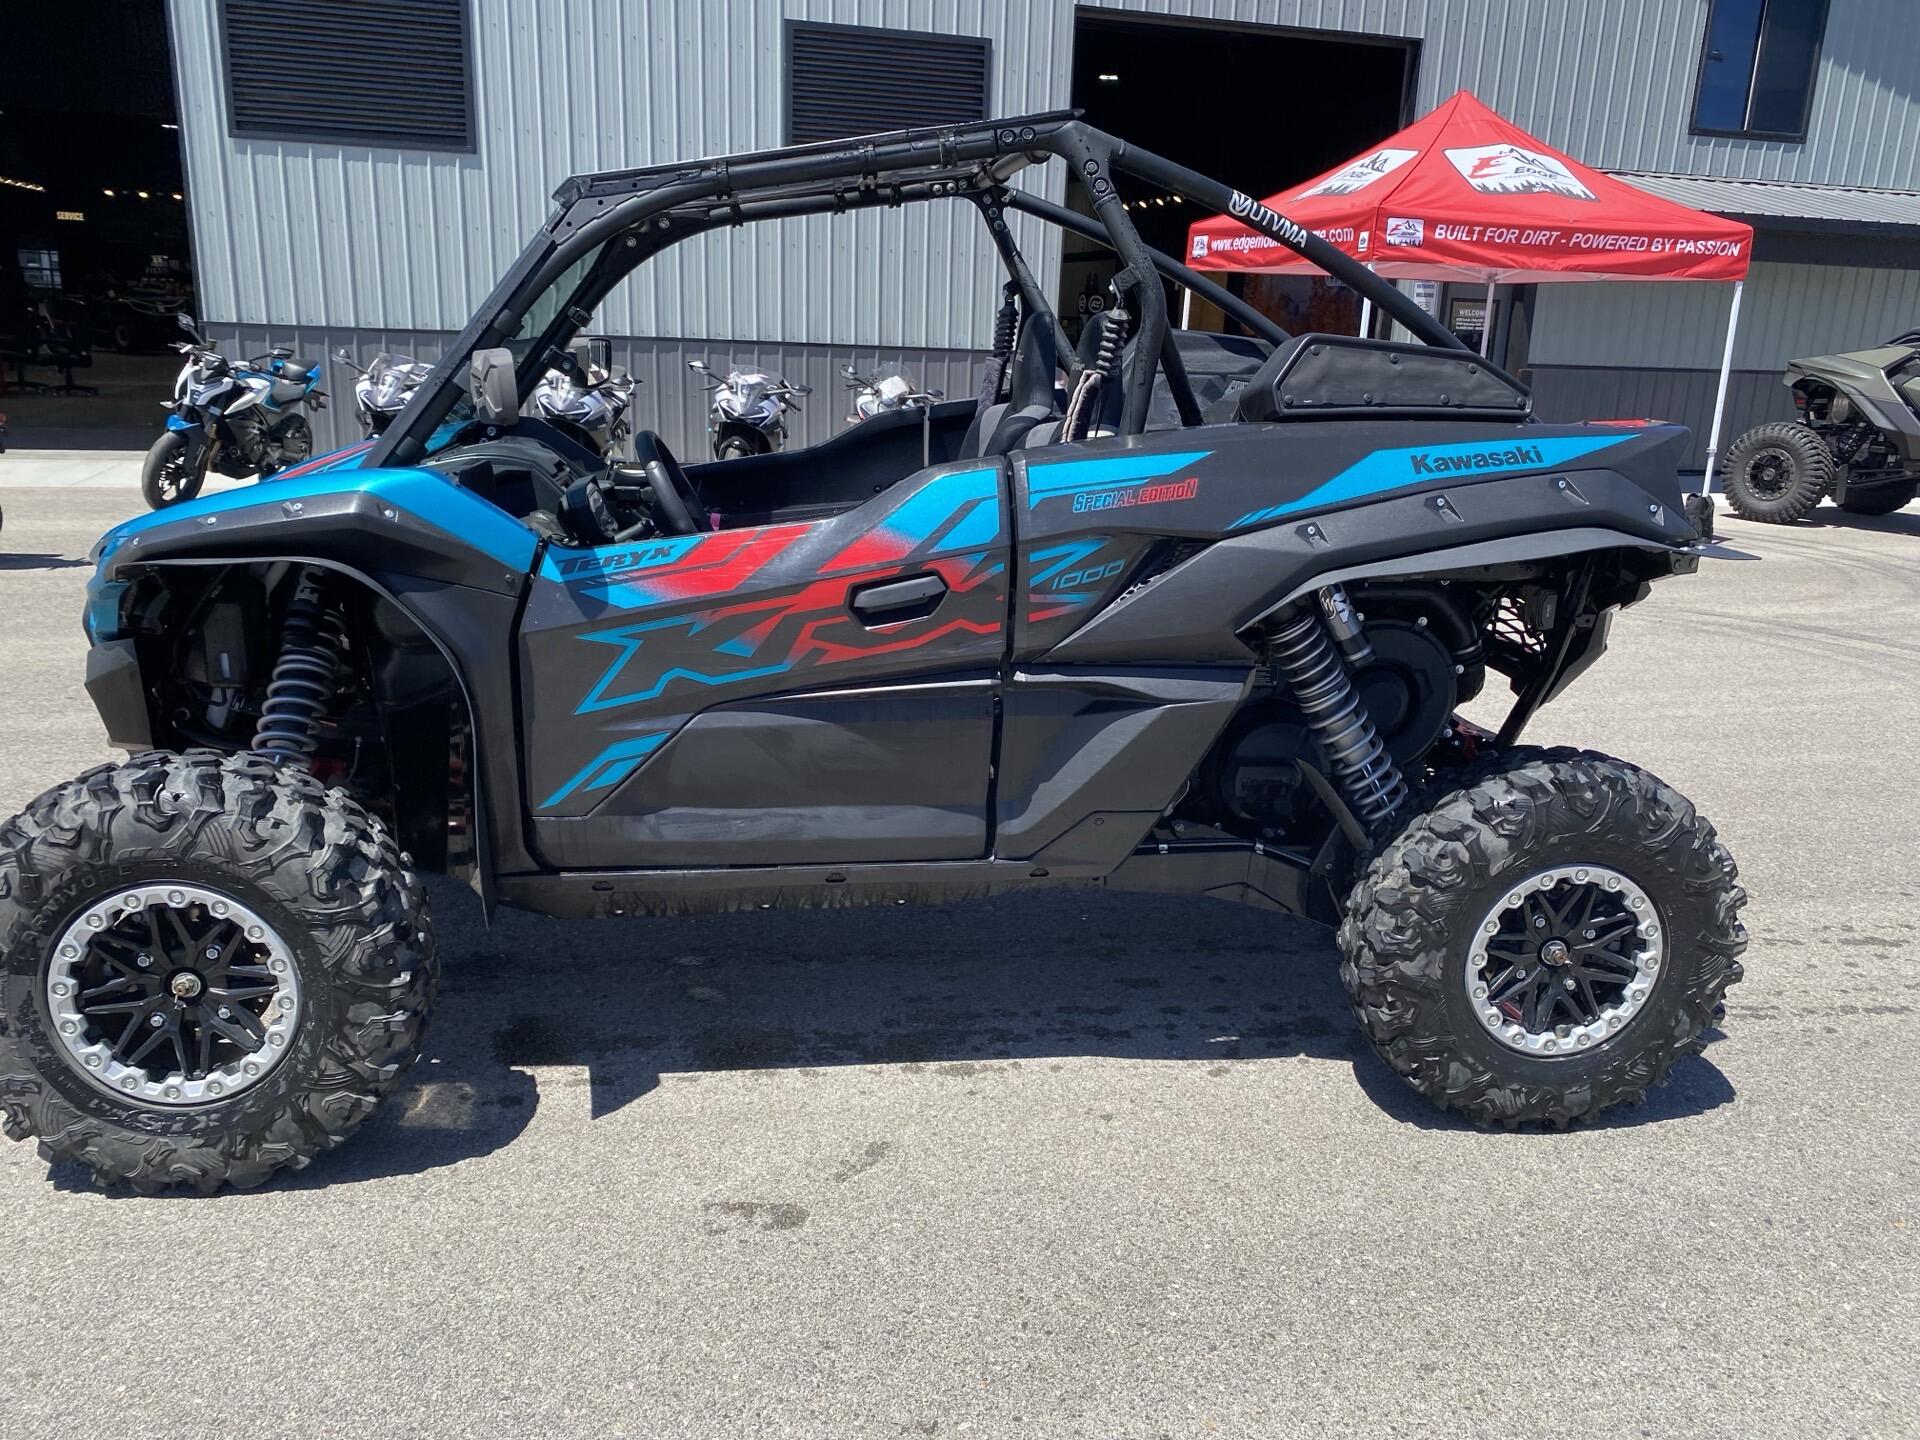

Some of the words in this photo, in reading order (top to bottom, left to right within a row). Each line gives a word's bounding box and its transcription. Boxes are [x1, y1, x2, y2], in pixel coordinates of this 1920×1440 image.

[56, 211, 84, 221] SERVICE
[1250, 201, 1308, 248] UTVMA
[1434, 224, 1482, 241] BUILT
[1484, 228, 1520, 244] FOR
[1520, 230, 1560, 246] DIRT
[1569, 232, 1649, 251] POWERED
[1651, 237, 1674, 252] BY
[1675, 239, 1741, 257] PASSION
[1410, 445, 1545, 475] Kawasaki
[1073, 488, 1136, 513] SPECIAL
[1138, 477, 1199, 504] EDITION
[554, 545, 677, 576] TERYX
[1052, 559, 1127, 590] 1000
